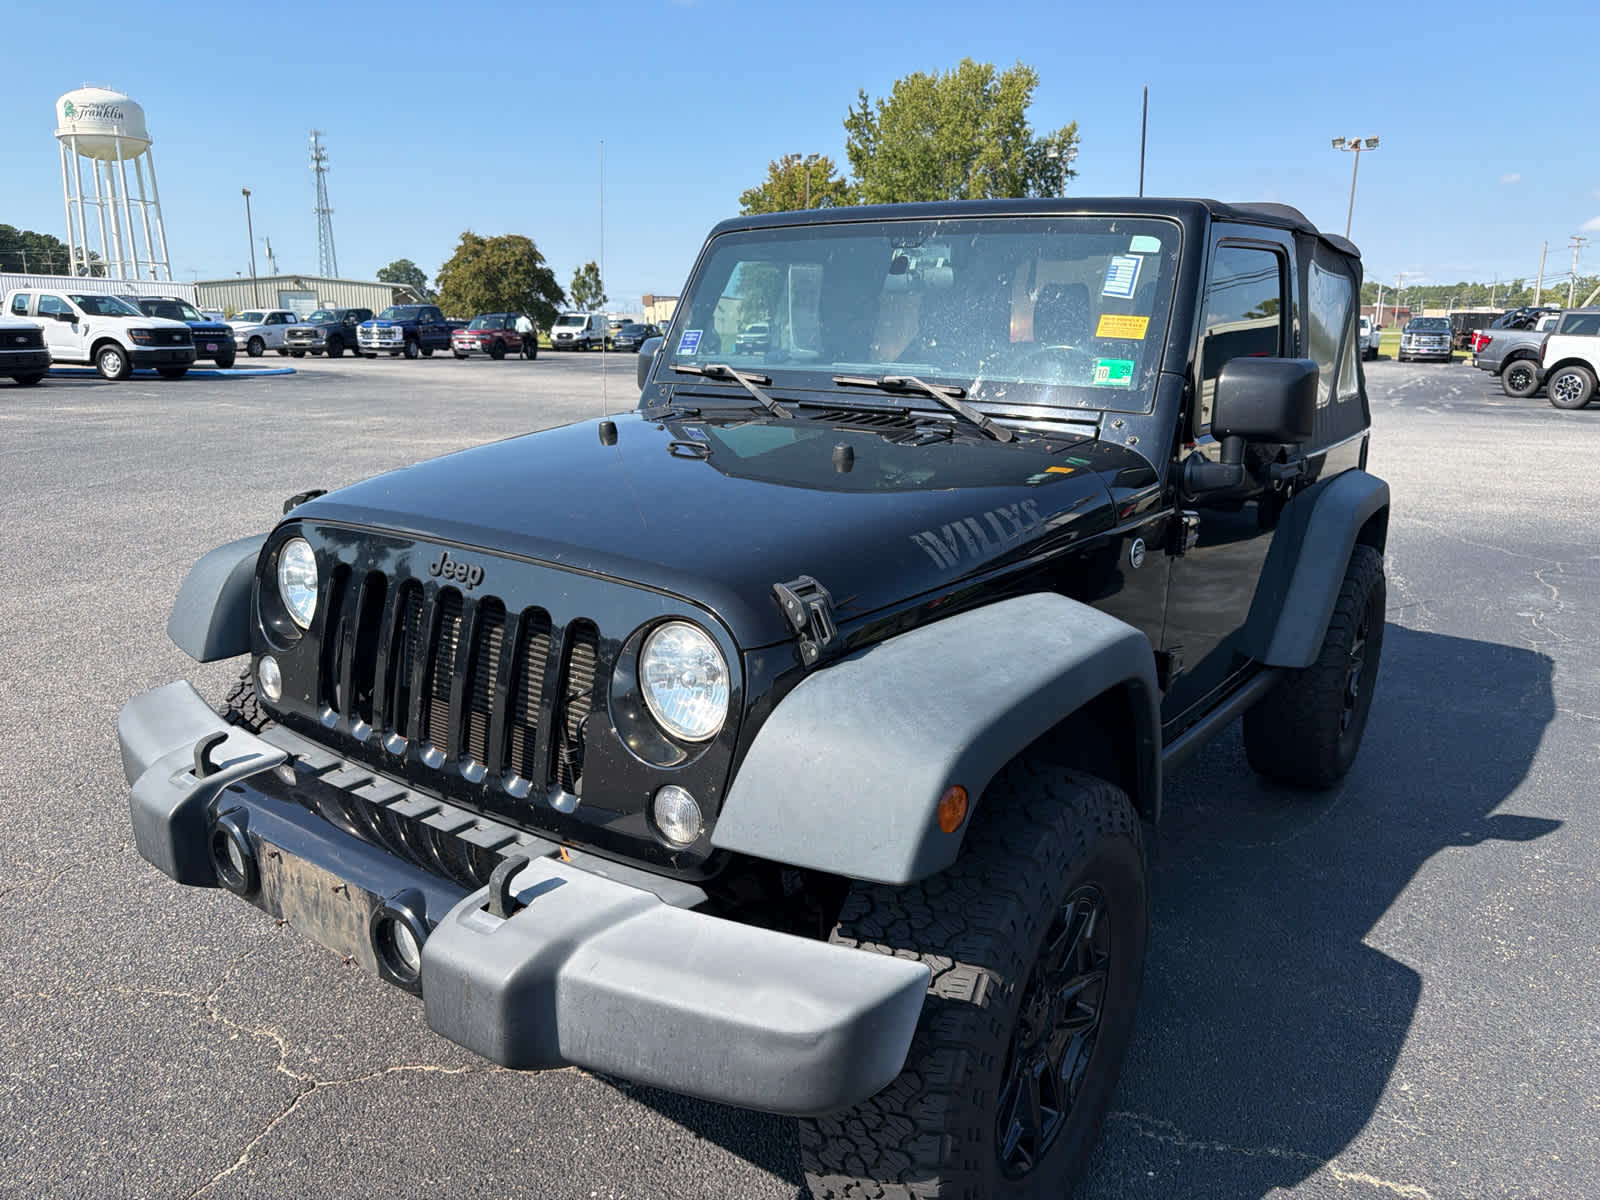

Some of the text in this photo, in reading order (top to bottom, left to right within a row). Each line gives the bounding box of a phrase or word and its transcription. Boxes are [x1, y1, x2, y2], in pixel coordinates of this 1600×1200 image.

[74, 103, 124, 121] Franklin
[909, 499, 1041, 569] WILLYS
[429, 551, 485, 590] Jeep
